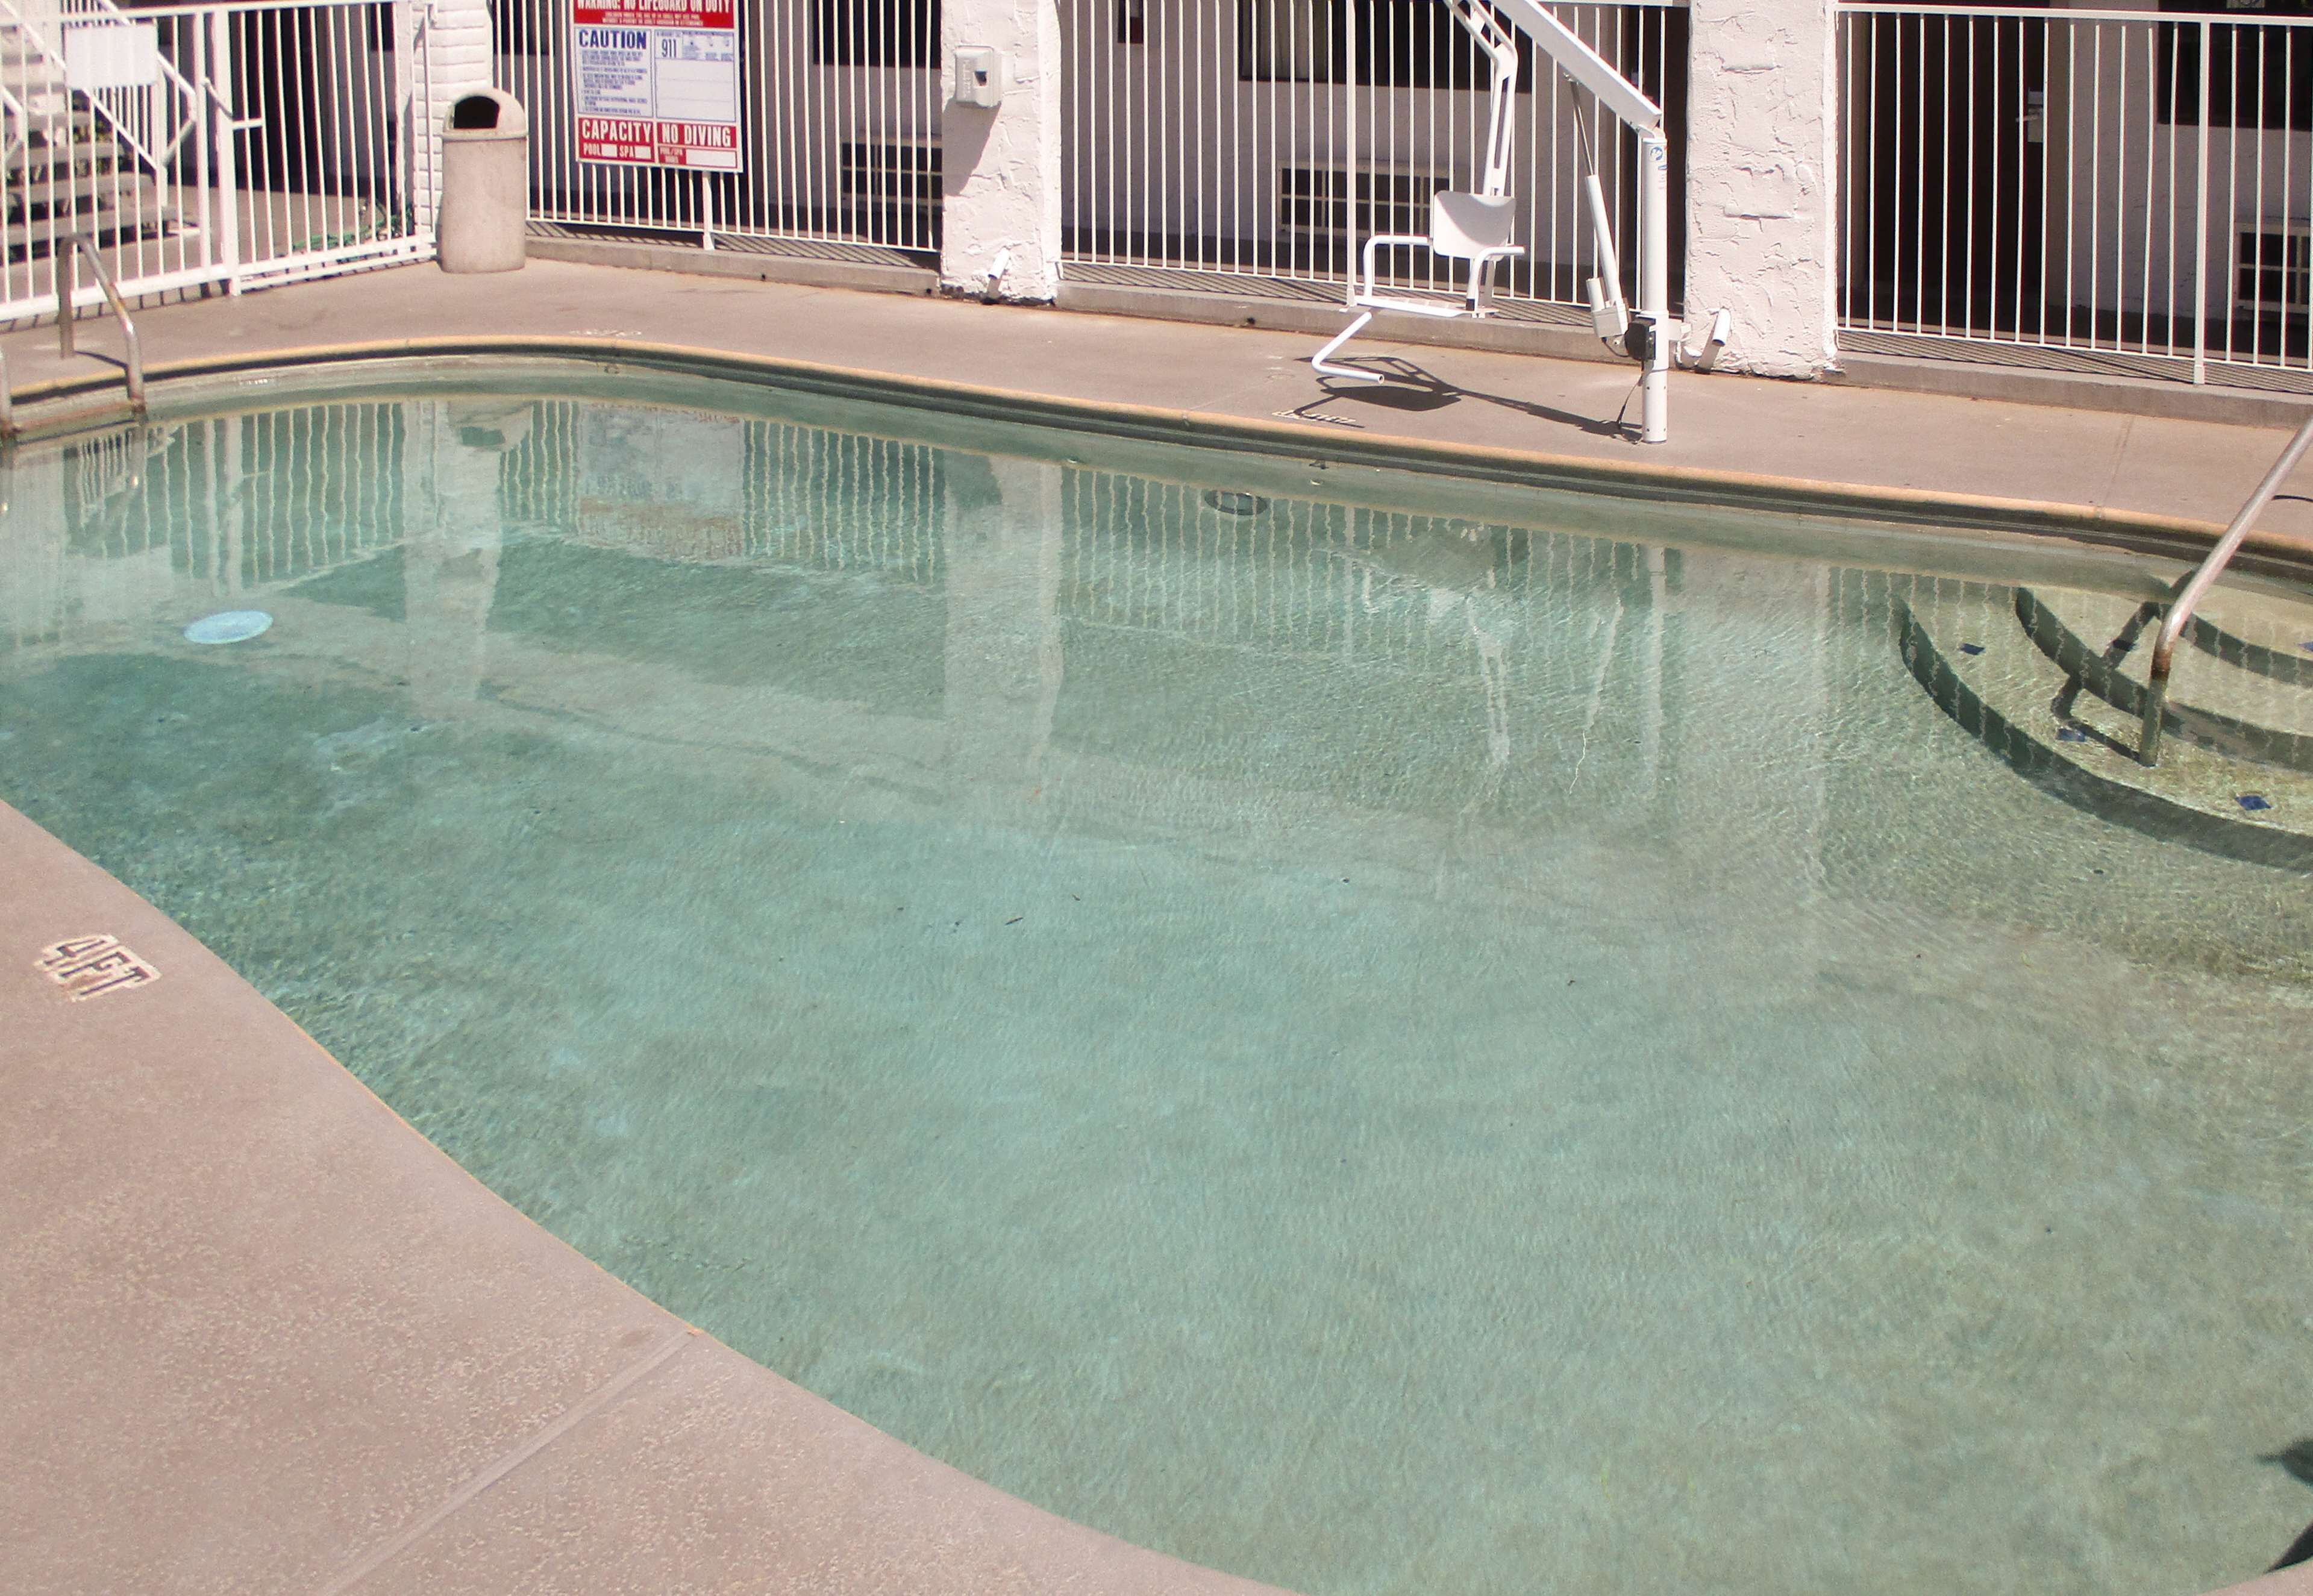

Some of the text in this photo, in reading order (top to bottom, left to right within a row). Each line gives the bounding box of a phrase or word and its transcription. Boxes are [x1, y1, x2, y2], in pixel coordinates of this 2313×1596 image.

[690, 0, 703, 13] ON
[705, 0, 730, 13] DUTY
[578, 30, 646, 49] CAUTION
[662, 39, 677, 58] 911
[581, 119, 651, 142] CAPACITY
[662, 124, 731, 147] NO DIVING
[583, 142, 634, 158] POOL SPA
